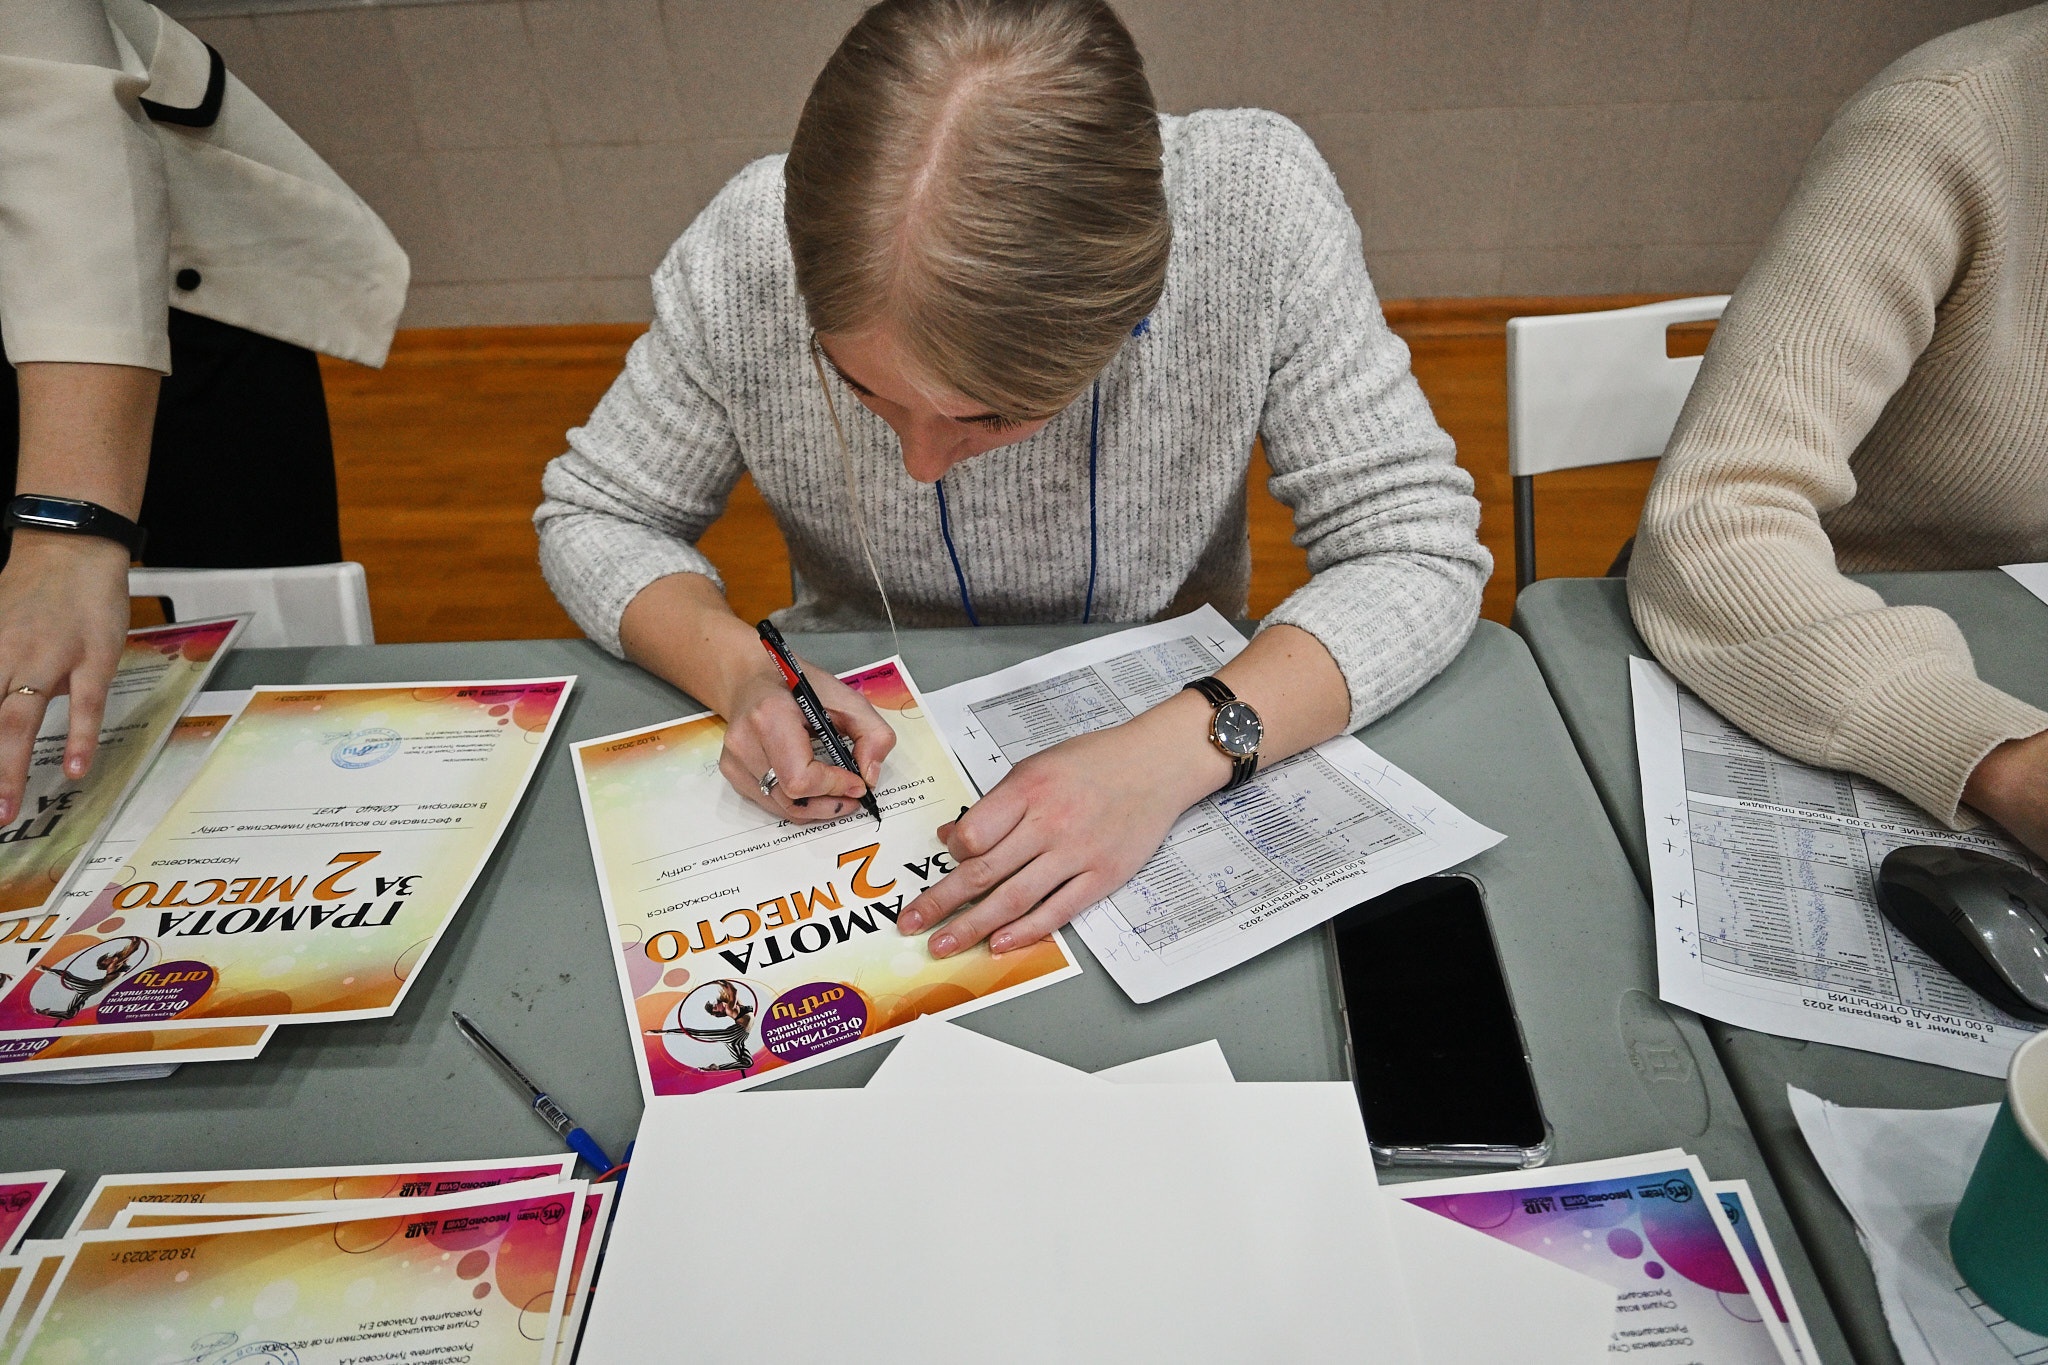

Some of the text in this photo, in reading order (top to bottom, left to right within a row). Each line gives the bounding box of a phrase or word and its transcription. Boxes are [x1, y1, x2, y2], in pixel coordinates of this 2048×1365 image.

[796, 695, 822, 730] MARKER
[874, 776, 935, 800] В категори
[38, 790, 83, 814] ЗА
[418, 802, 477, 810] категории
[1739, 801, 1795, 814] площадки
[307, 819, 370, 830] воздушной
[389, 817, 453, 827] фестивале
[839, 815, 853, 825] по
[1799, 811, 1832, 821] проба
[237, 823, 304, 832] гимнастике
[773, 820, 836, 846] воздушной
[1900, 827, 1996, 847] НАГРАЖДЕНИЕ
[150, 856, 241, 867] Награждается
[702, 840, 770, 866] гимнастике
[112, 851, 423, 910] ЗА 2 МЕСТО
[1307, 864, 1342, 887] ПАРАД
[645, 843, 955, 963] ЗА 2 МЕСТО
[647, 886, 740, 918] Награждается
[1239, 868, 1368, 930] Тайминг 18 февраля 2023
[1249, 885, 1308, 915] ОТКРЫТИЯ
[157, 901, 404, 938] ГРАМОТА
[719, 886, 930, 974] АМОТА
[133, 970, 208, 987] artFly
[99, 1000, 189, 1014] ФЕСТИВАЛЬ
[772, 987, 844, 1020] artFly
[1802, 999, 1988, 1043] Тайминг 18 февраля 2023
[1827, 992, 1994, 1033] 8:00 ПАРАД ОТКРЫТИЯ
[766, 1008, 838, 1037] гимнастике
[768, 1015, 840, 1044] по воздушной
[771, 1017, 862, 1053] ФЕСТИВАЛЬ
[399, 1185, 425, 1197] AIR
[1638, 1189, 1665, 1199] team
[517, 1211, 539, 1221] team
[1525, 1203, 1550, 1214] AIR
[405, 1226, 431, 1238] AIR
[123, 1247, 197, 1263] 18.02.2023
[420, 1308, 483, 1321] Руководитель
[393, 1325, 445, 1338] воздушной
[447, 1320, 480, 1329] Студия
[336, 1331, 391, 1342] гимнастики
[410, 1343, 474, 1356] Руководитель
